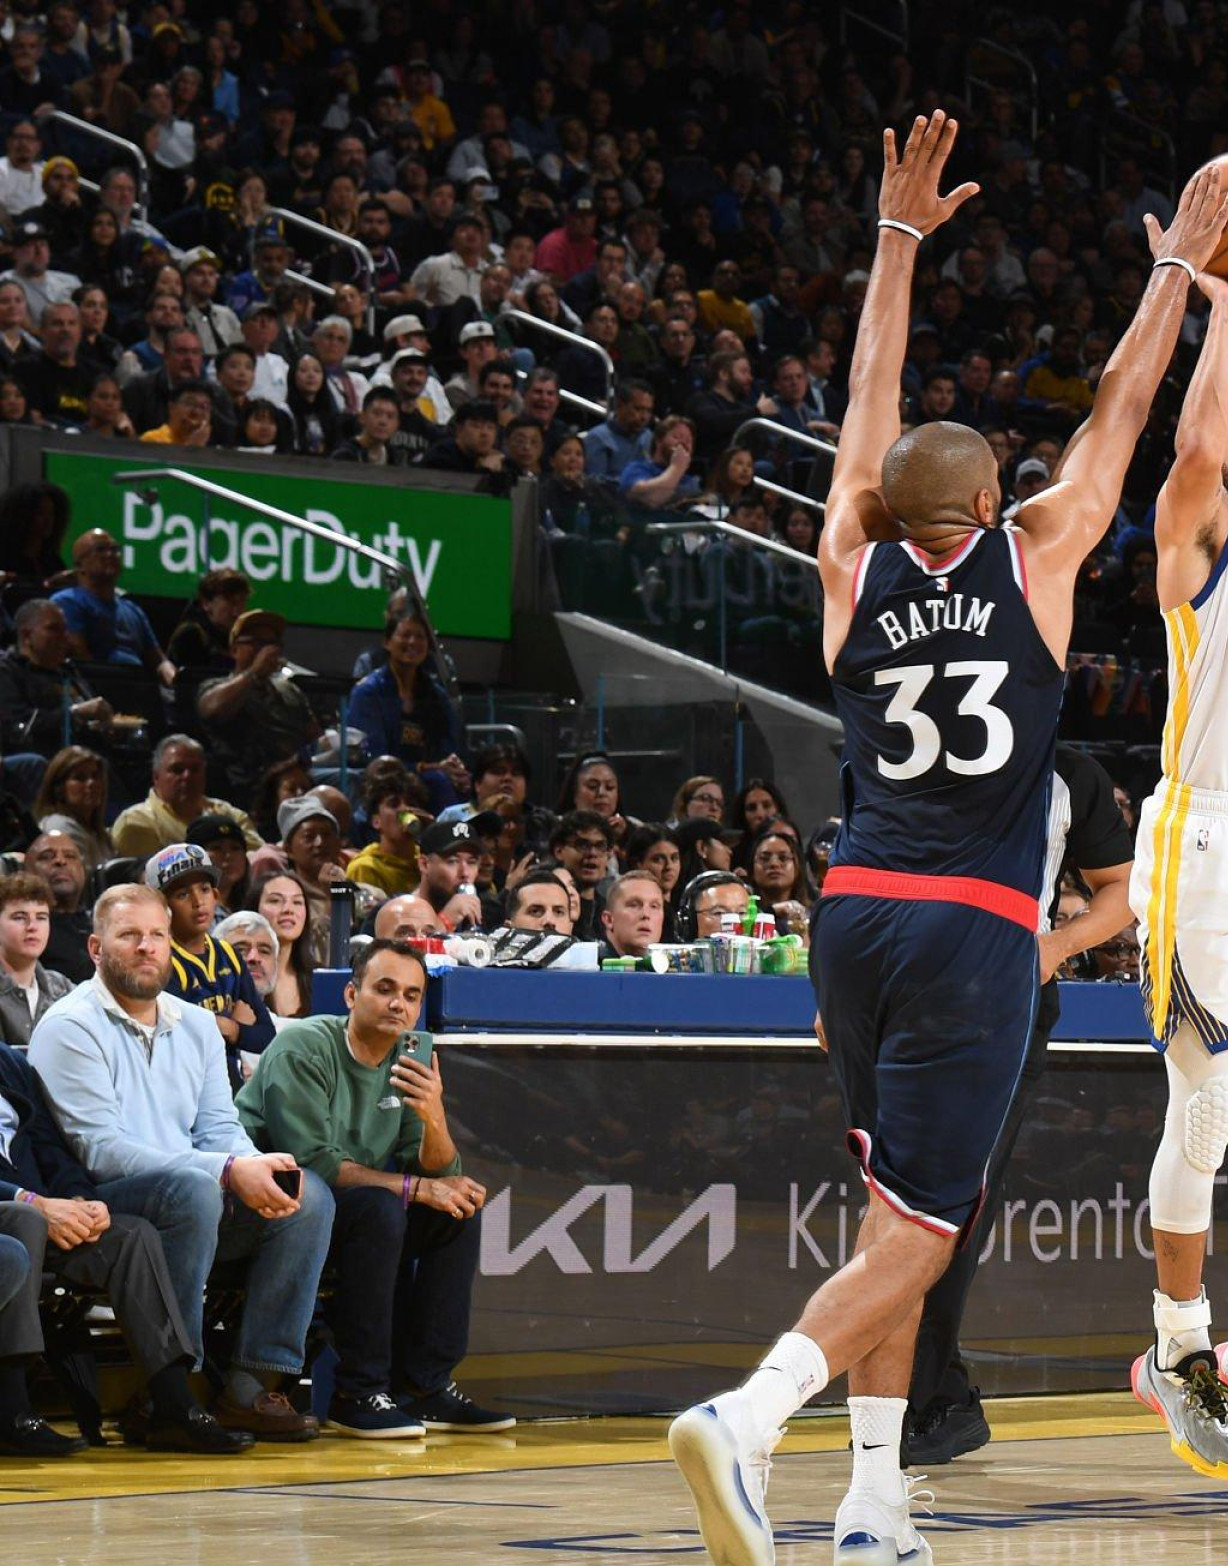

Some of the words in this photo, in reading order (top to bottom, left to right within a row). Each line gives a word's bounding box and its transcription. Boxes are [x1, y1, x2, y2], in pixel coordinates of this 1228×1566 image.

[122, 491, 443, 600] PagerDuty
[876, 593, 996, 650] BATUM
[873, 660, 1015, 781] 33
[788, 1182, 870, 1269] Ki
